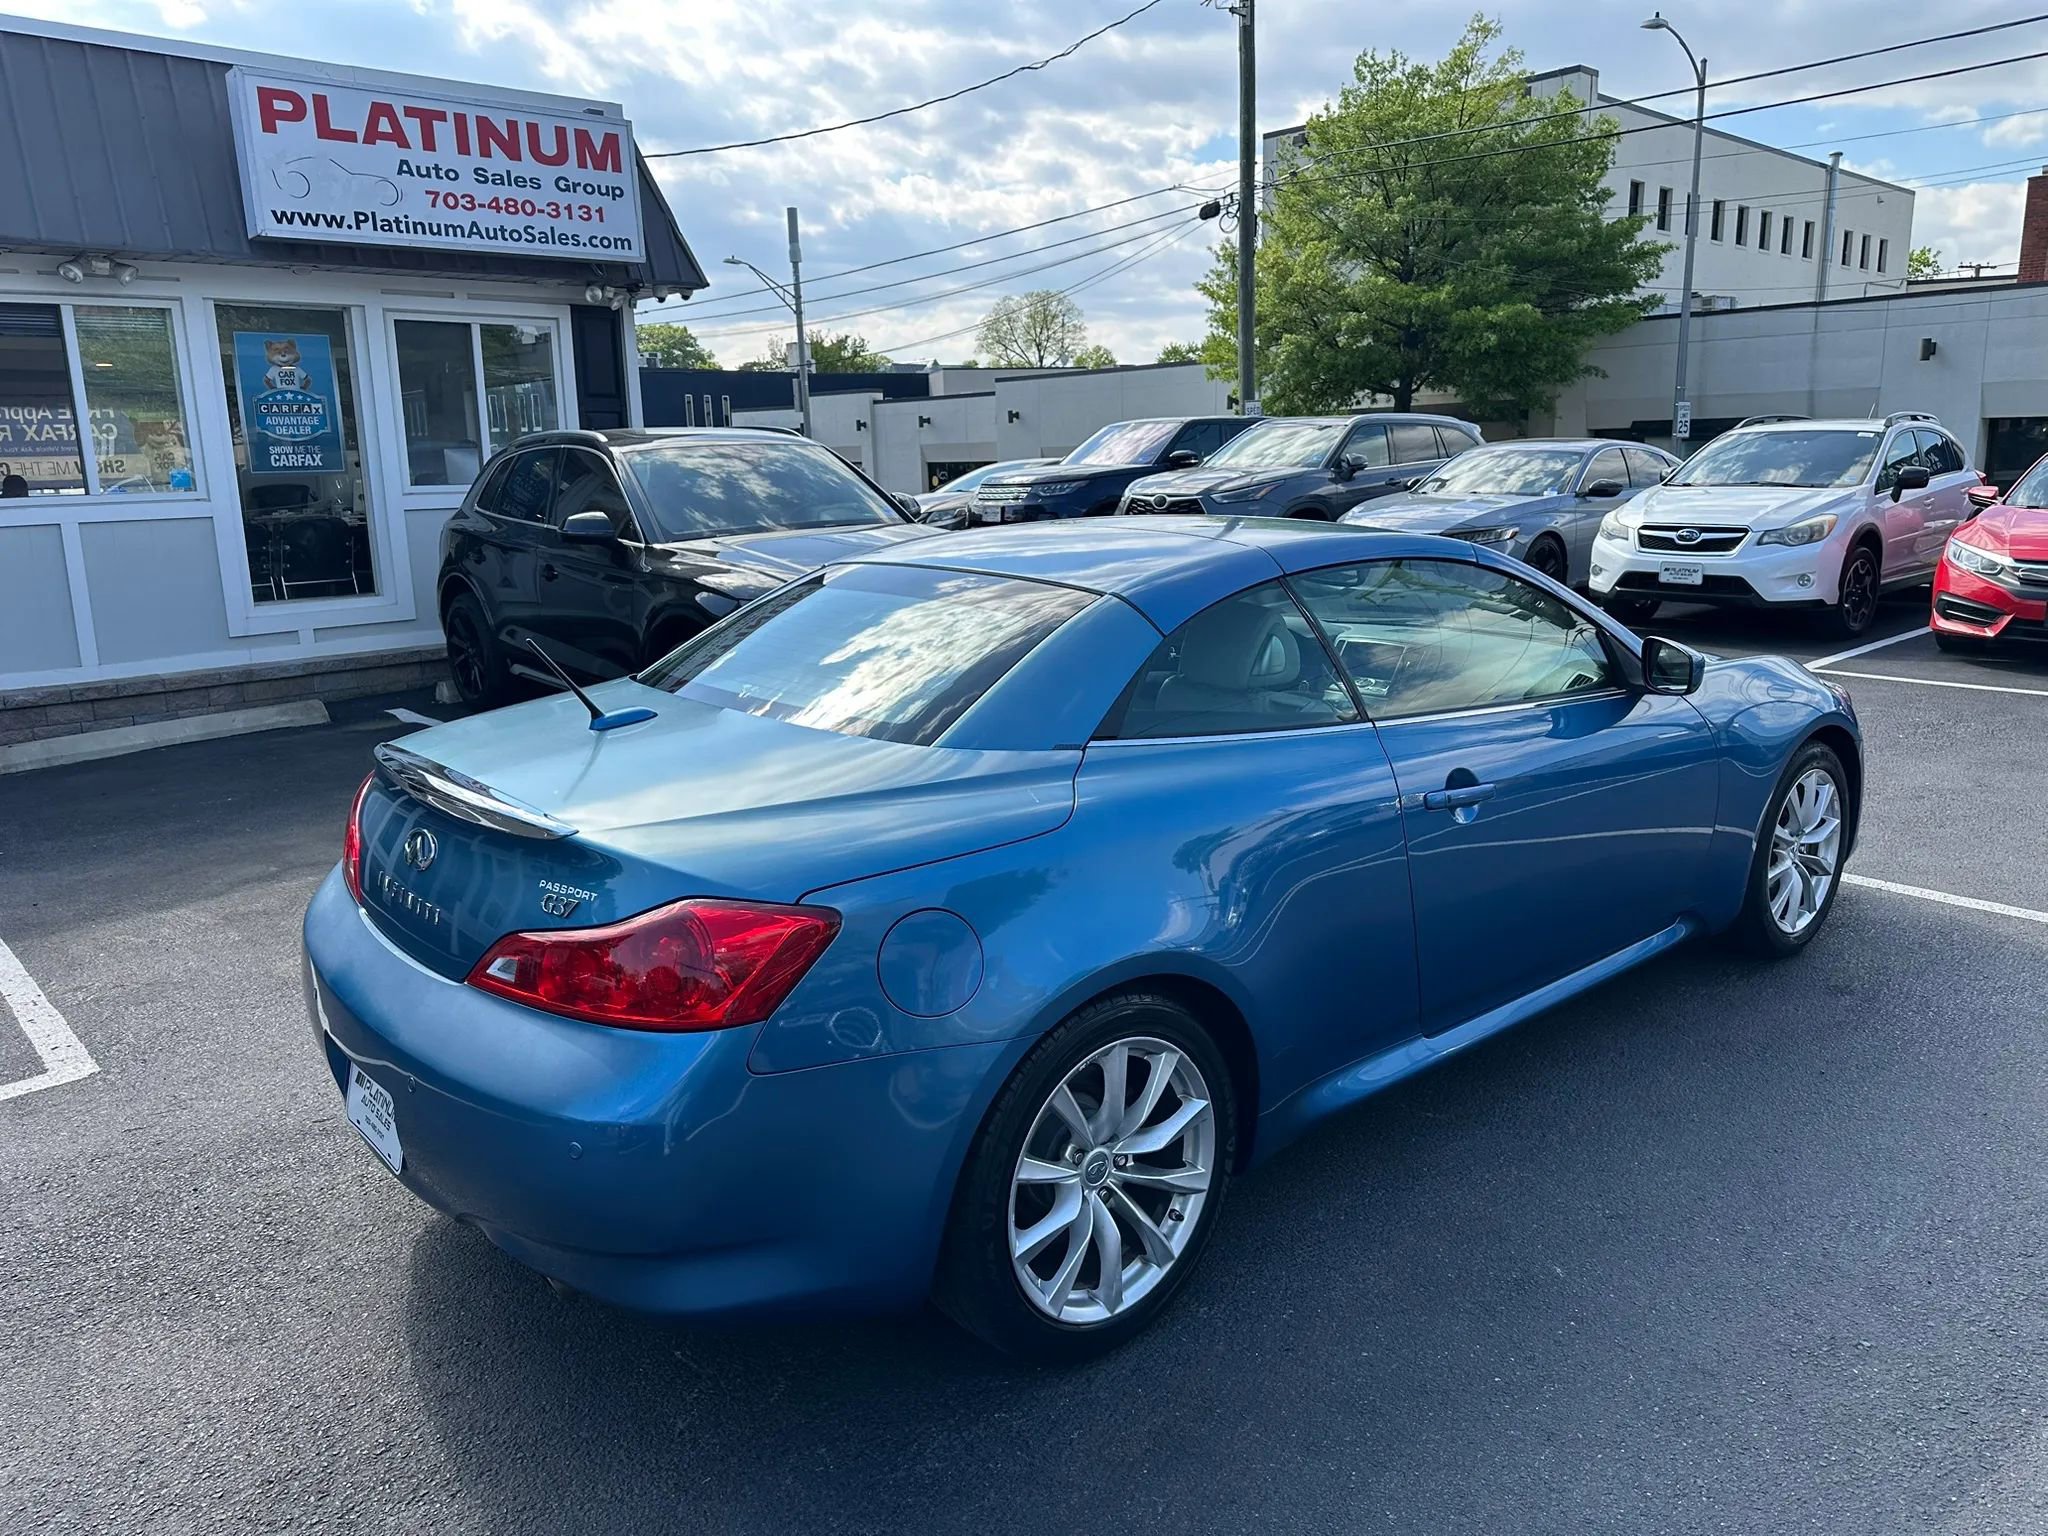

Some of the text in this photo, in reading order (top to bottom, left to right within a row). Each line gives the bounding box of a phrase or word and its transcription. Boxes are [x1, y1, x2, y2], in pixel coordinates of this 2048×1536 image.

[256, 86, 623, 174] PLATINUM
[396, 159, 624, 201] Auto Sales Group
[425, 190, 605, 223] 703-480-3131
[271, 207, 632, 251] www.PlatinumAutoSales.com
[259, 403, 323, 415] CARFAX
[266, 416, 320, 425] ADVANTAGE
[276, 426, 312, 435] DEALER
[1678, 420, 1689, 434] 25
[269, 446, 321, 454] SHOW ME THE
[270, 454, 323, 467] CARFAX
[378, 870, 441, 926] INFINITI
[539, 879, 599, 902] PASSPORT
[540, 893, 579, 918] G37
[361, 1094, 376, 1113] AUTO
[374, 1108, 392, 1132] SALES
